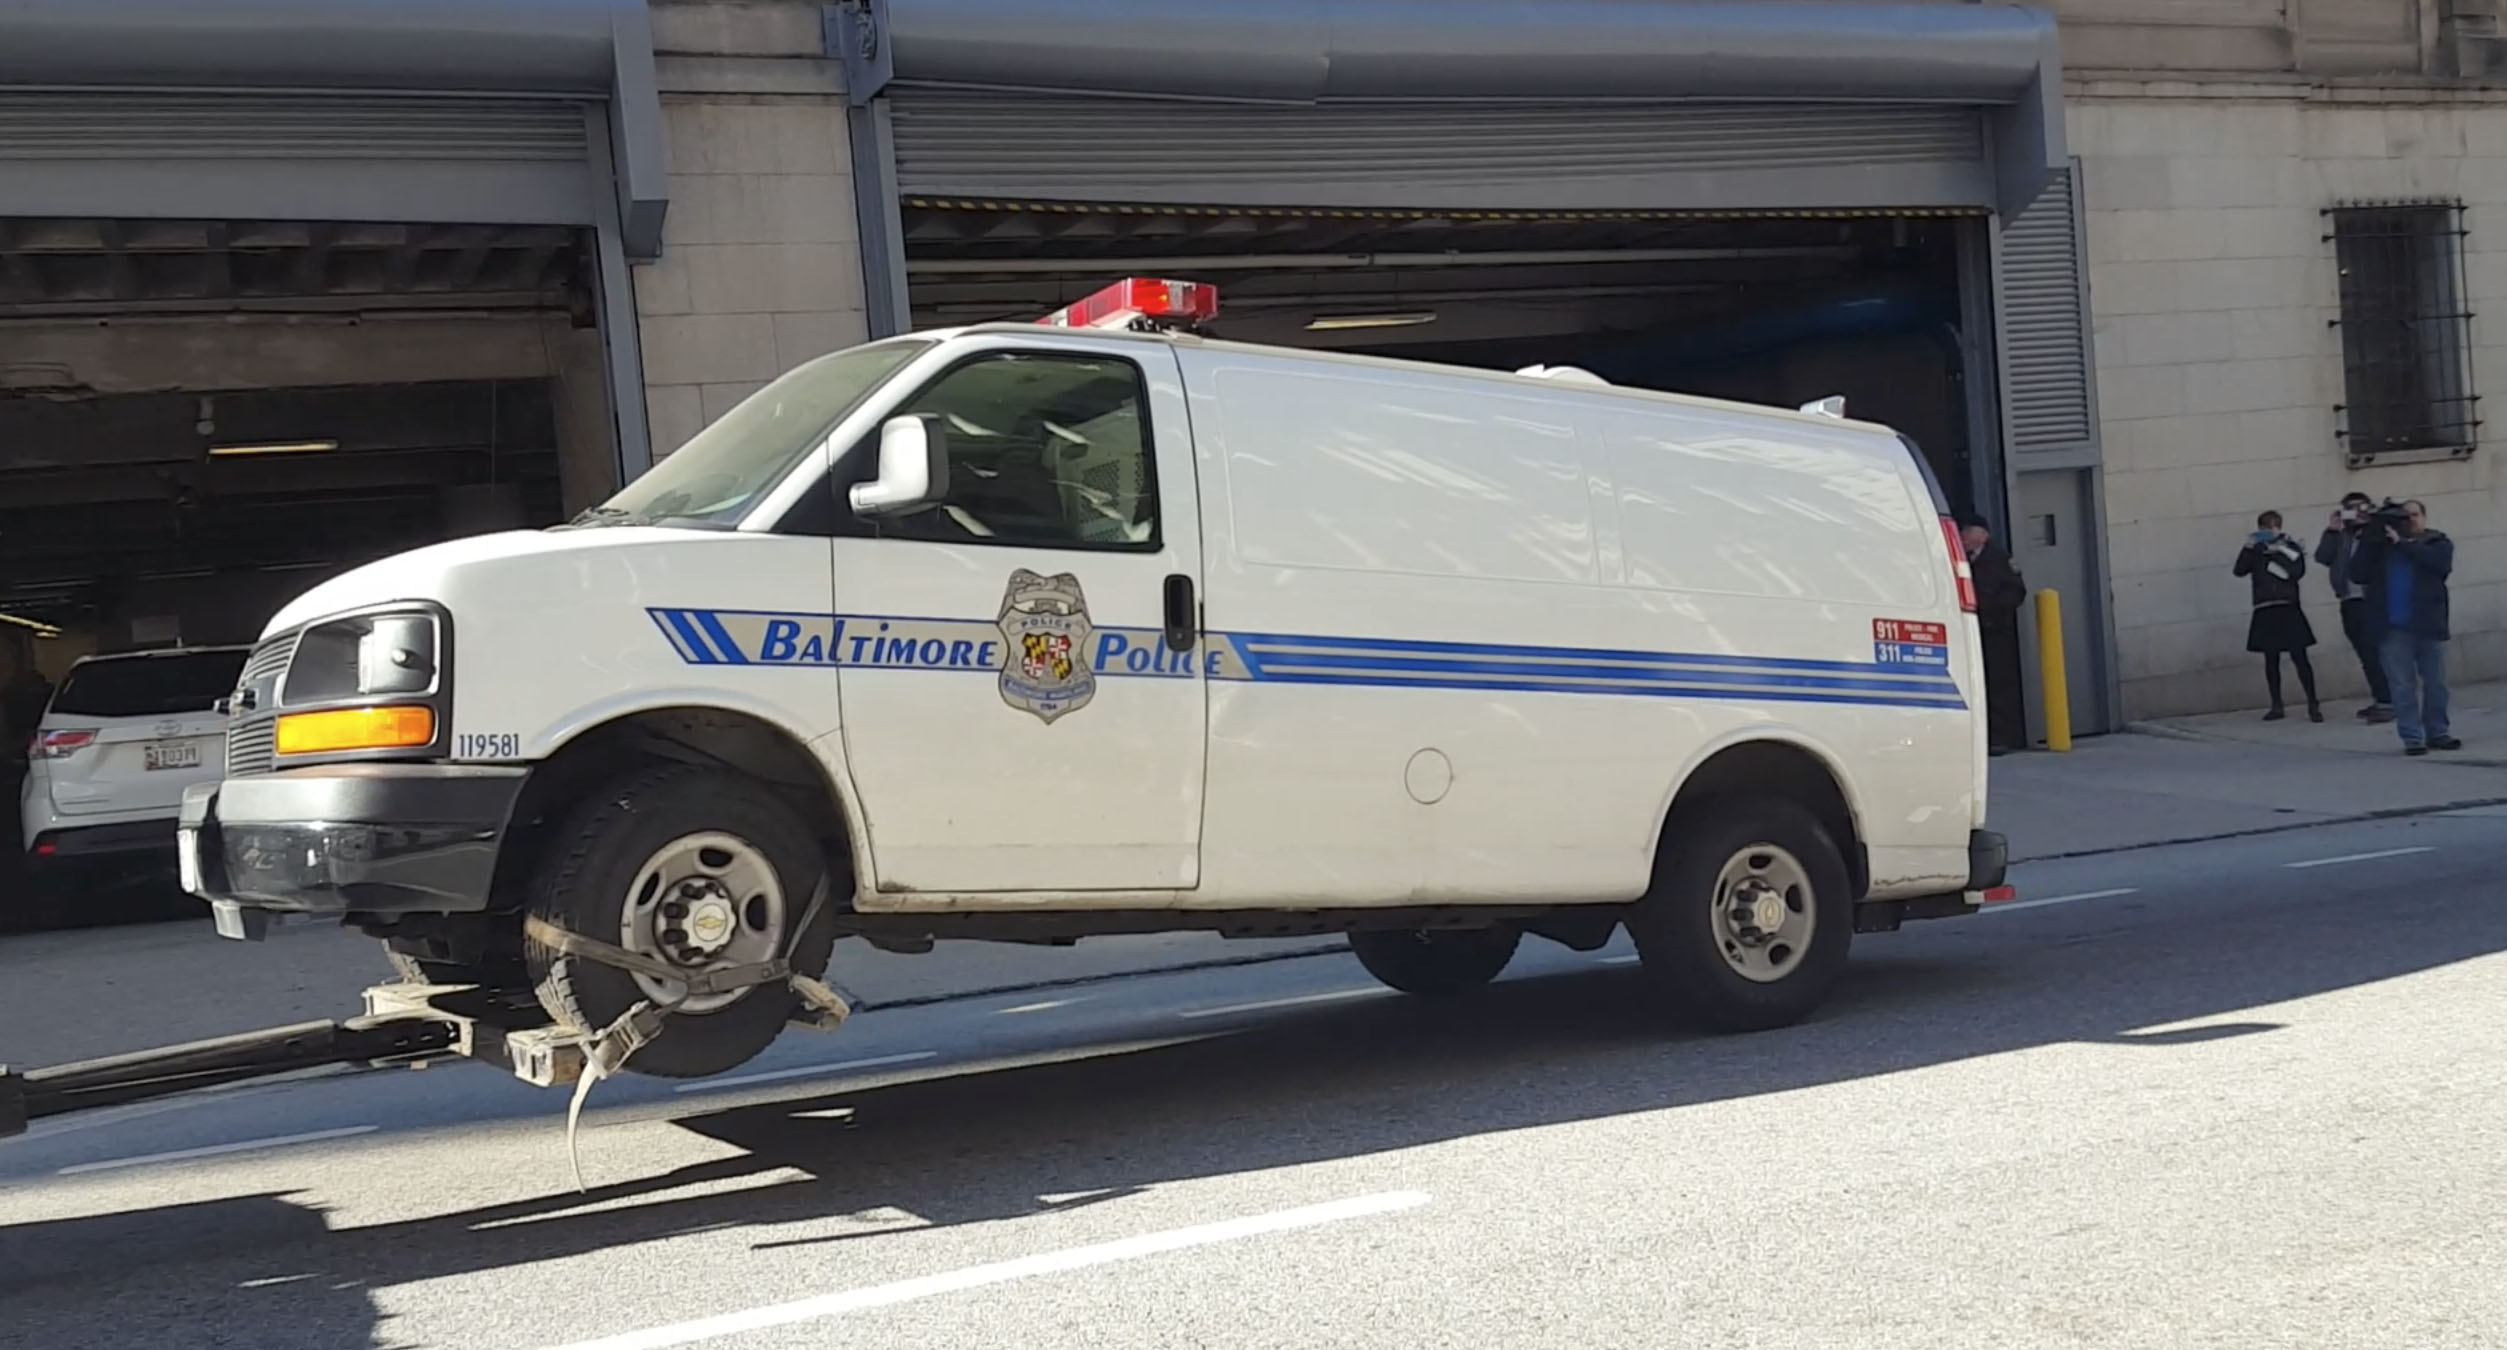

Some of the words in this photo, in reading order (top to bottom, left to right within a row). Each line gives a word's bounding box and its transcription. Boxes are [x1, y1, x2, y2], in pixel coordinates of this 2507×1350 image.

[1021, 617, 1072, 630] POLICE
[1876, 621, 1899, 640] 911
[1878, 643, 1901, 663] 311
[459, 733, 519, 757] 119581
